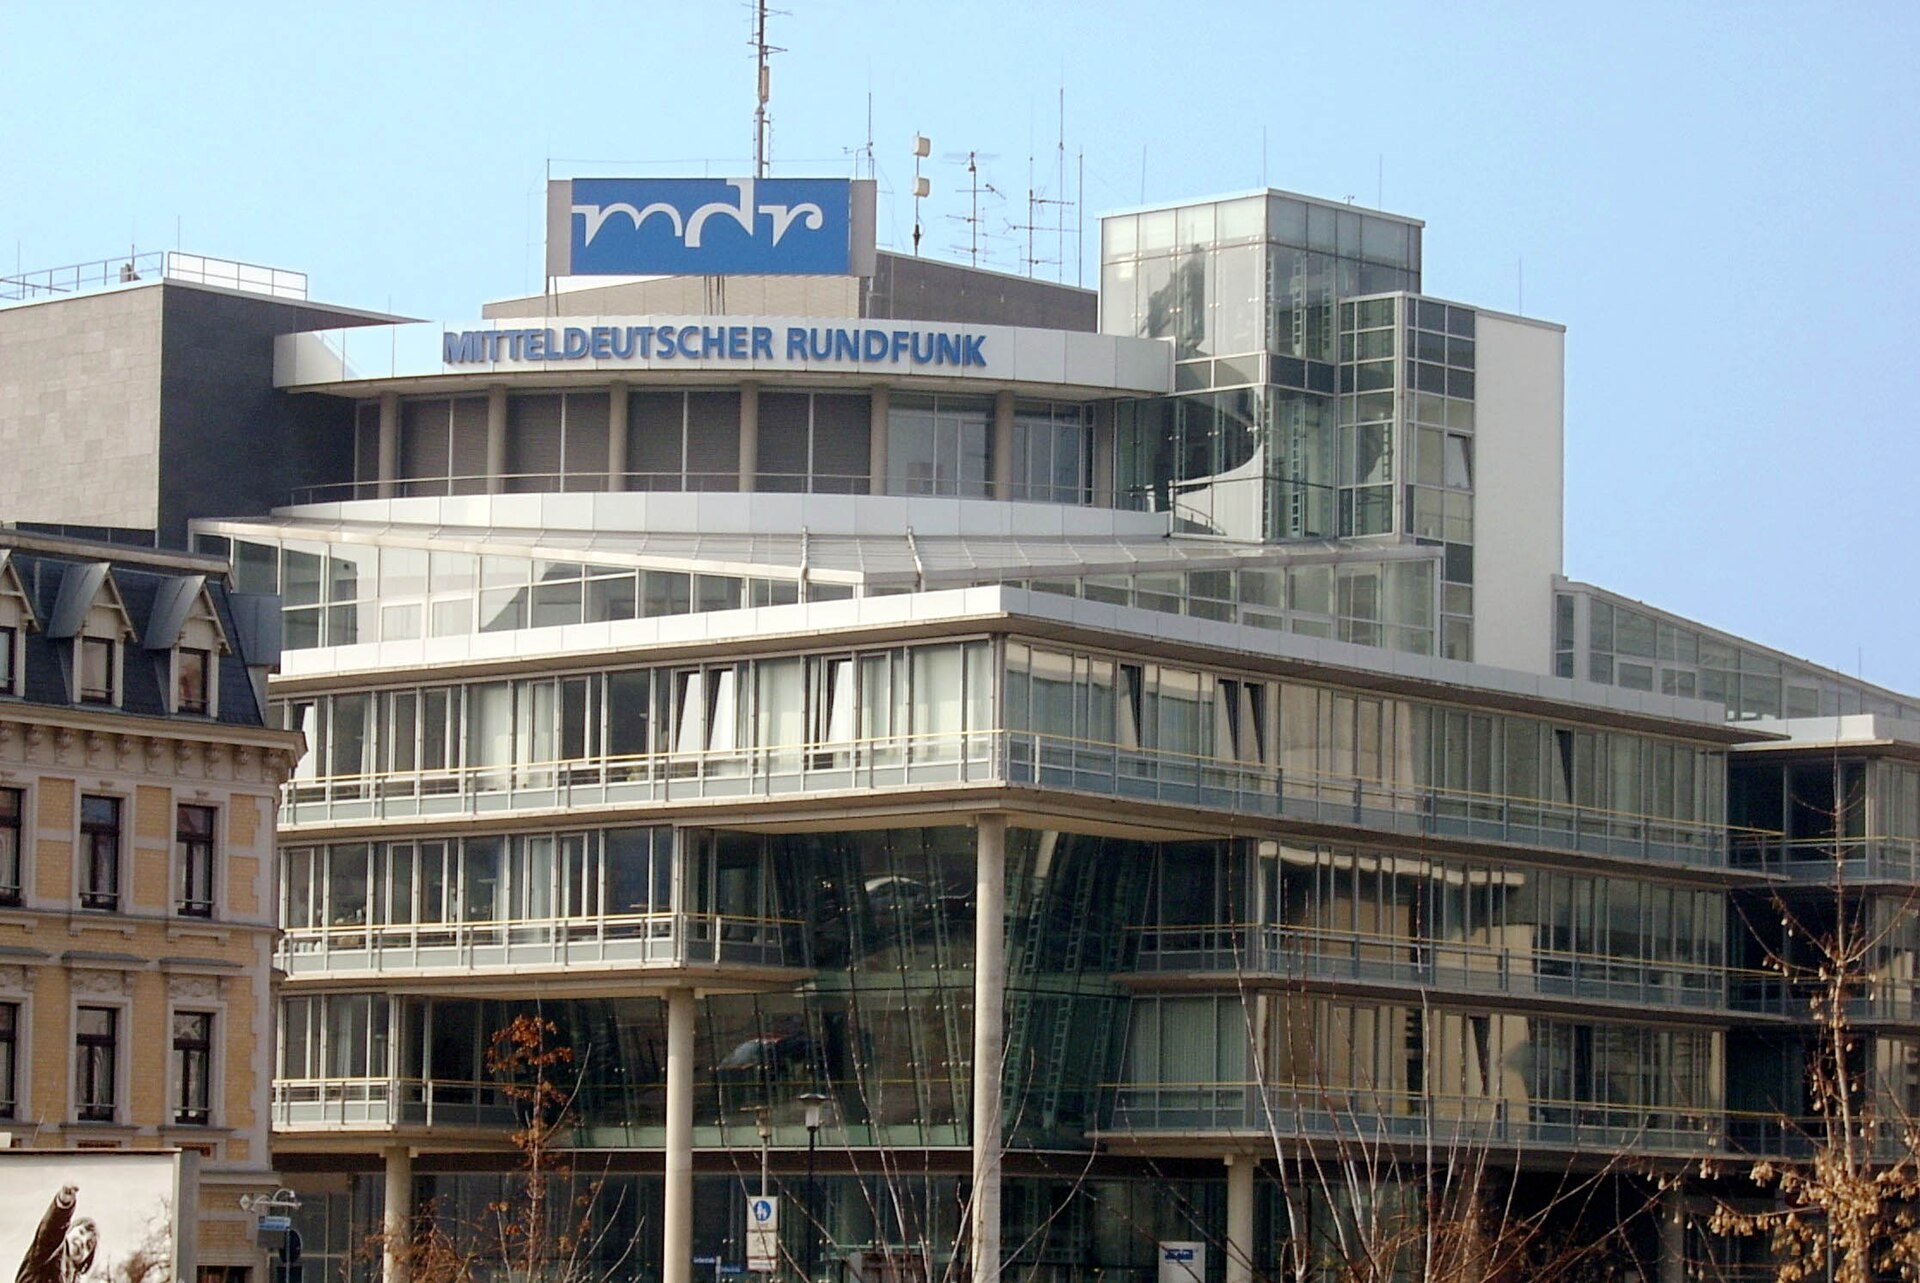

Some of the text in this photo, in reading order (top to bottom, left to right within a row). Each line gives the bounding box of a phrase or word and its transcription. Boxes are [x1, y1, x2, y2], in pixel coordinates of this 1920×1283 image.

[572, 178, 823, 248] mdr
[443, 325, 987, 367] MITTELDEUTSCHER RUNDFUNK
